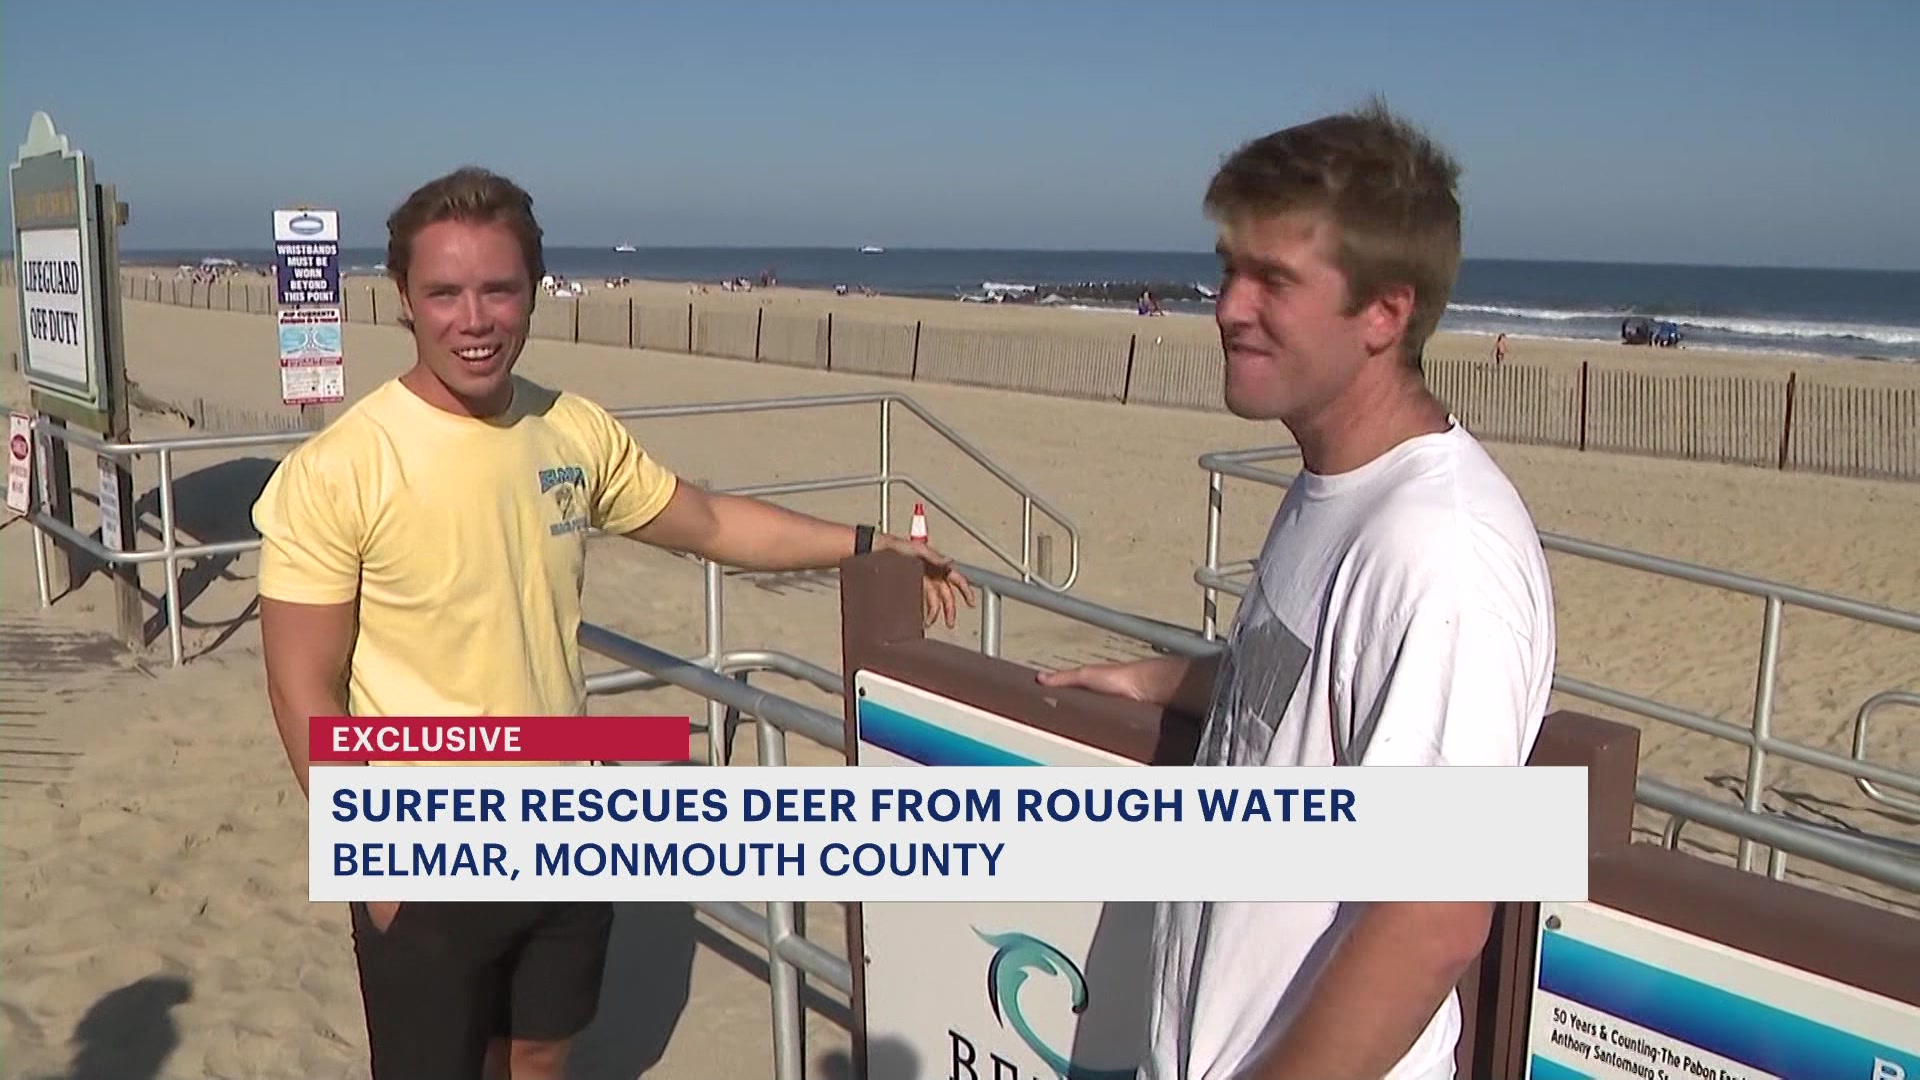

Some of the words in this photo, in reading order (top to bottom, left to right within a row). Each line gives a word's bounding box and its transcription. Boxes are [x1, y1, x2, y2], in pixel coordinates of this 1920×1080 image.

[276, 244, 337, 255] WRISTBANDS
[287, 256, 313, 267] MUST
[315, 256, 328, 267] BE
[24, 260, 79, 295] LIFEGUARD
[294, 268, 322, 279] WORN
[290, 280, 327, 291] BEYOND
[284, 291, 305, 302] THIS
[307, 291, 334, 302] POINT
[30, 307, 47, 341] OFF
[48, 309, 78, 346] DUTY
[1553, 1007, 1567, 1024] 50
[1570, 1013, 1597, 1036] Years
[1600, 1025, 1608, 1041] &
[1683, 1056, 1716, 1080] Pabon
[1551, 1029, 1592, 1059] Anthony
[1594, 1045, 1655, 1080] Santomauro
